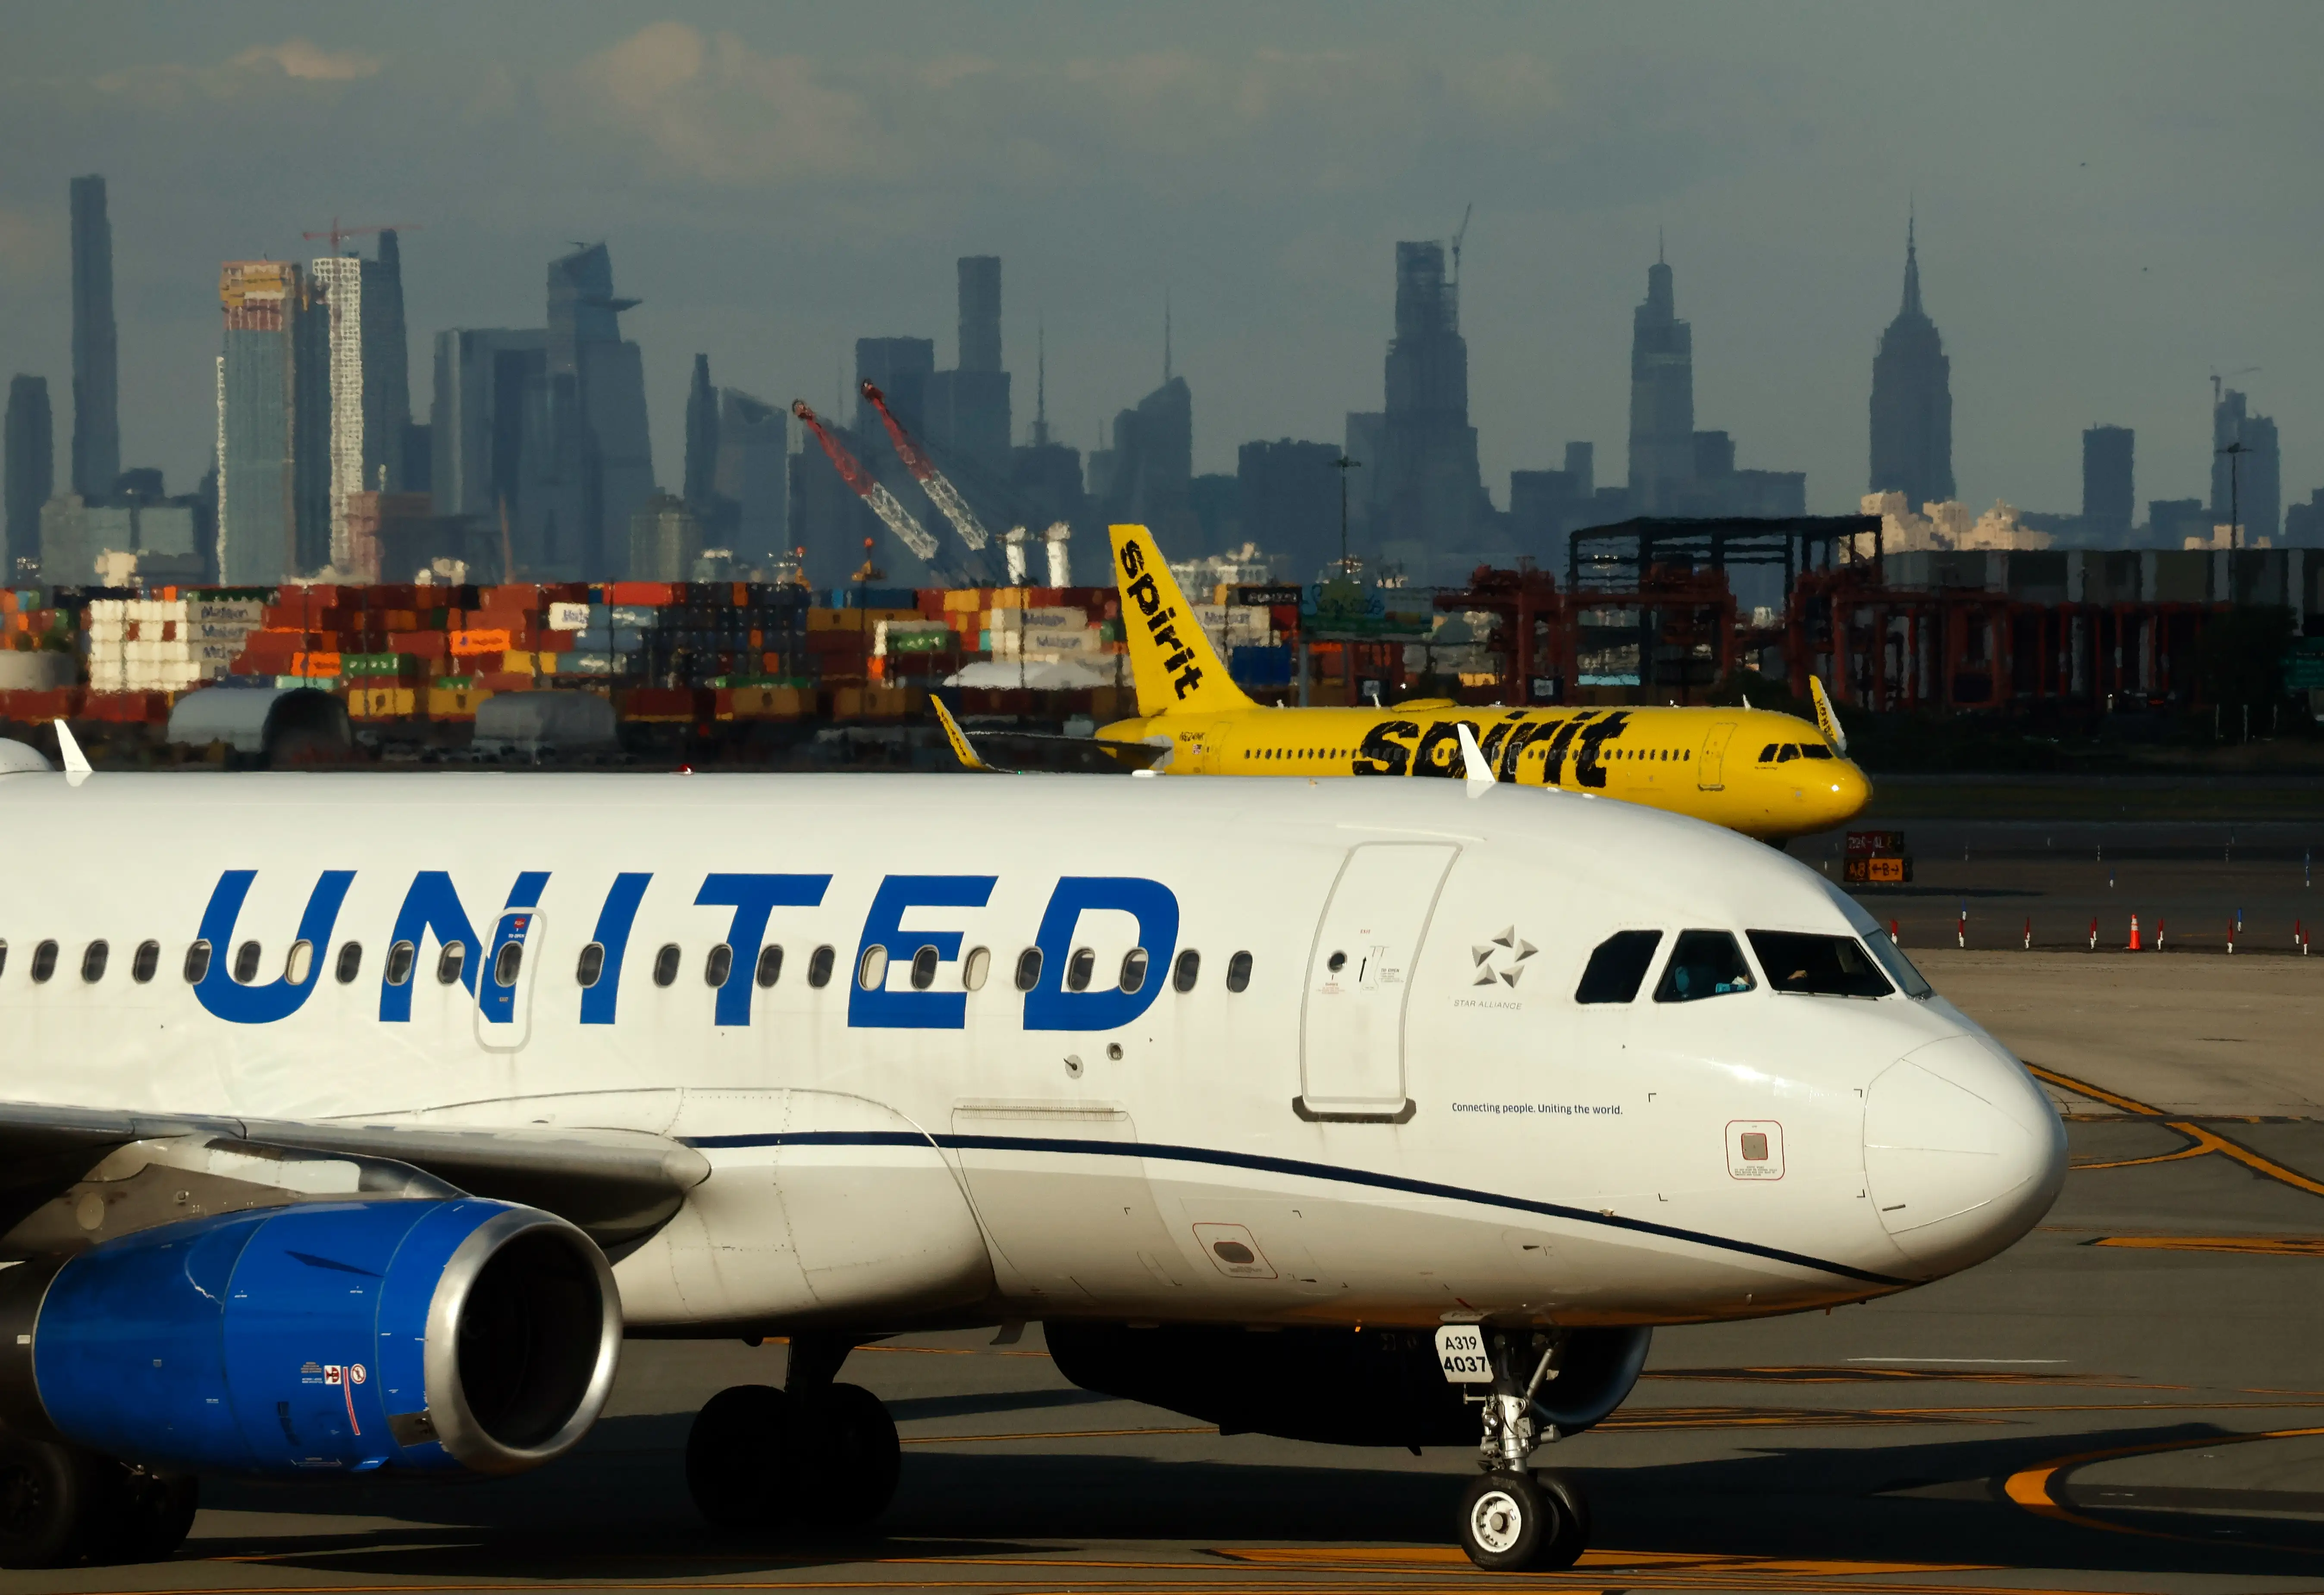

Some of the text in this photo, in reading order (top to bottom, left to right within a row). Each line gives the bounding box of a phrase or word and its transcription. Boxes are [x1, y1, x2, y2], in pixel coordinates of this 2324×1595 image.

[1120, 539, 1203, 700] spirit
[194, 871, 1179, 1030] UNITED
[1478, 1001, 1522, 1010] ALLIANCE
[1452, 1102, 1623, 1115] Connecting people. Uniting the world.
[1446, 1336, 1477, 1350] A319
[1443, 1356, 1486, 1373] 4037
